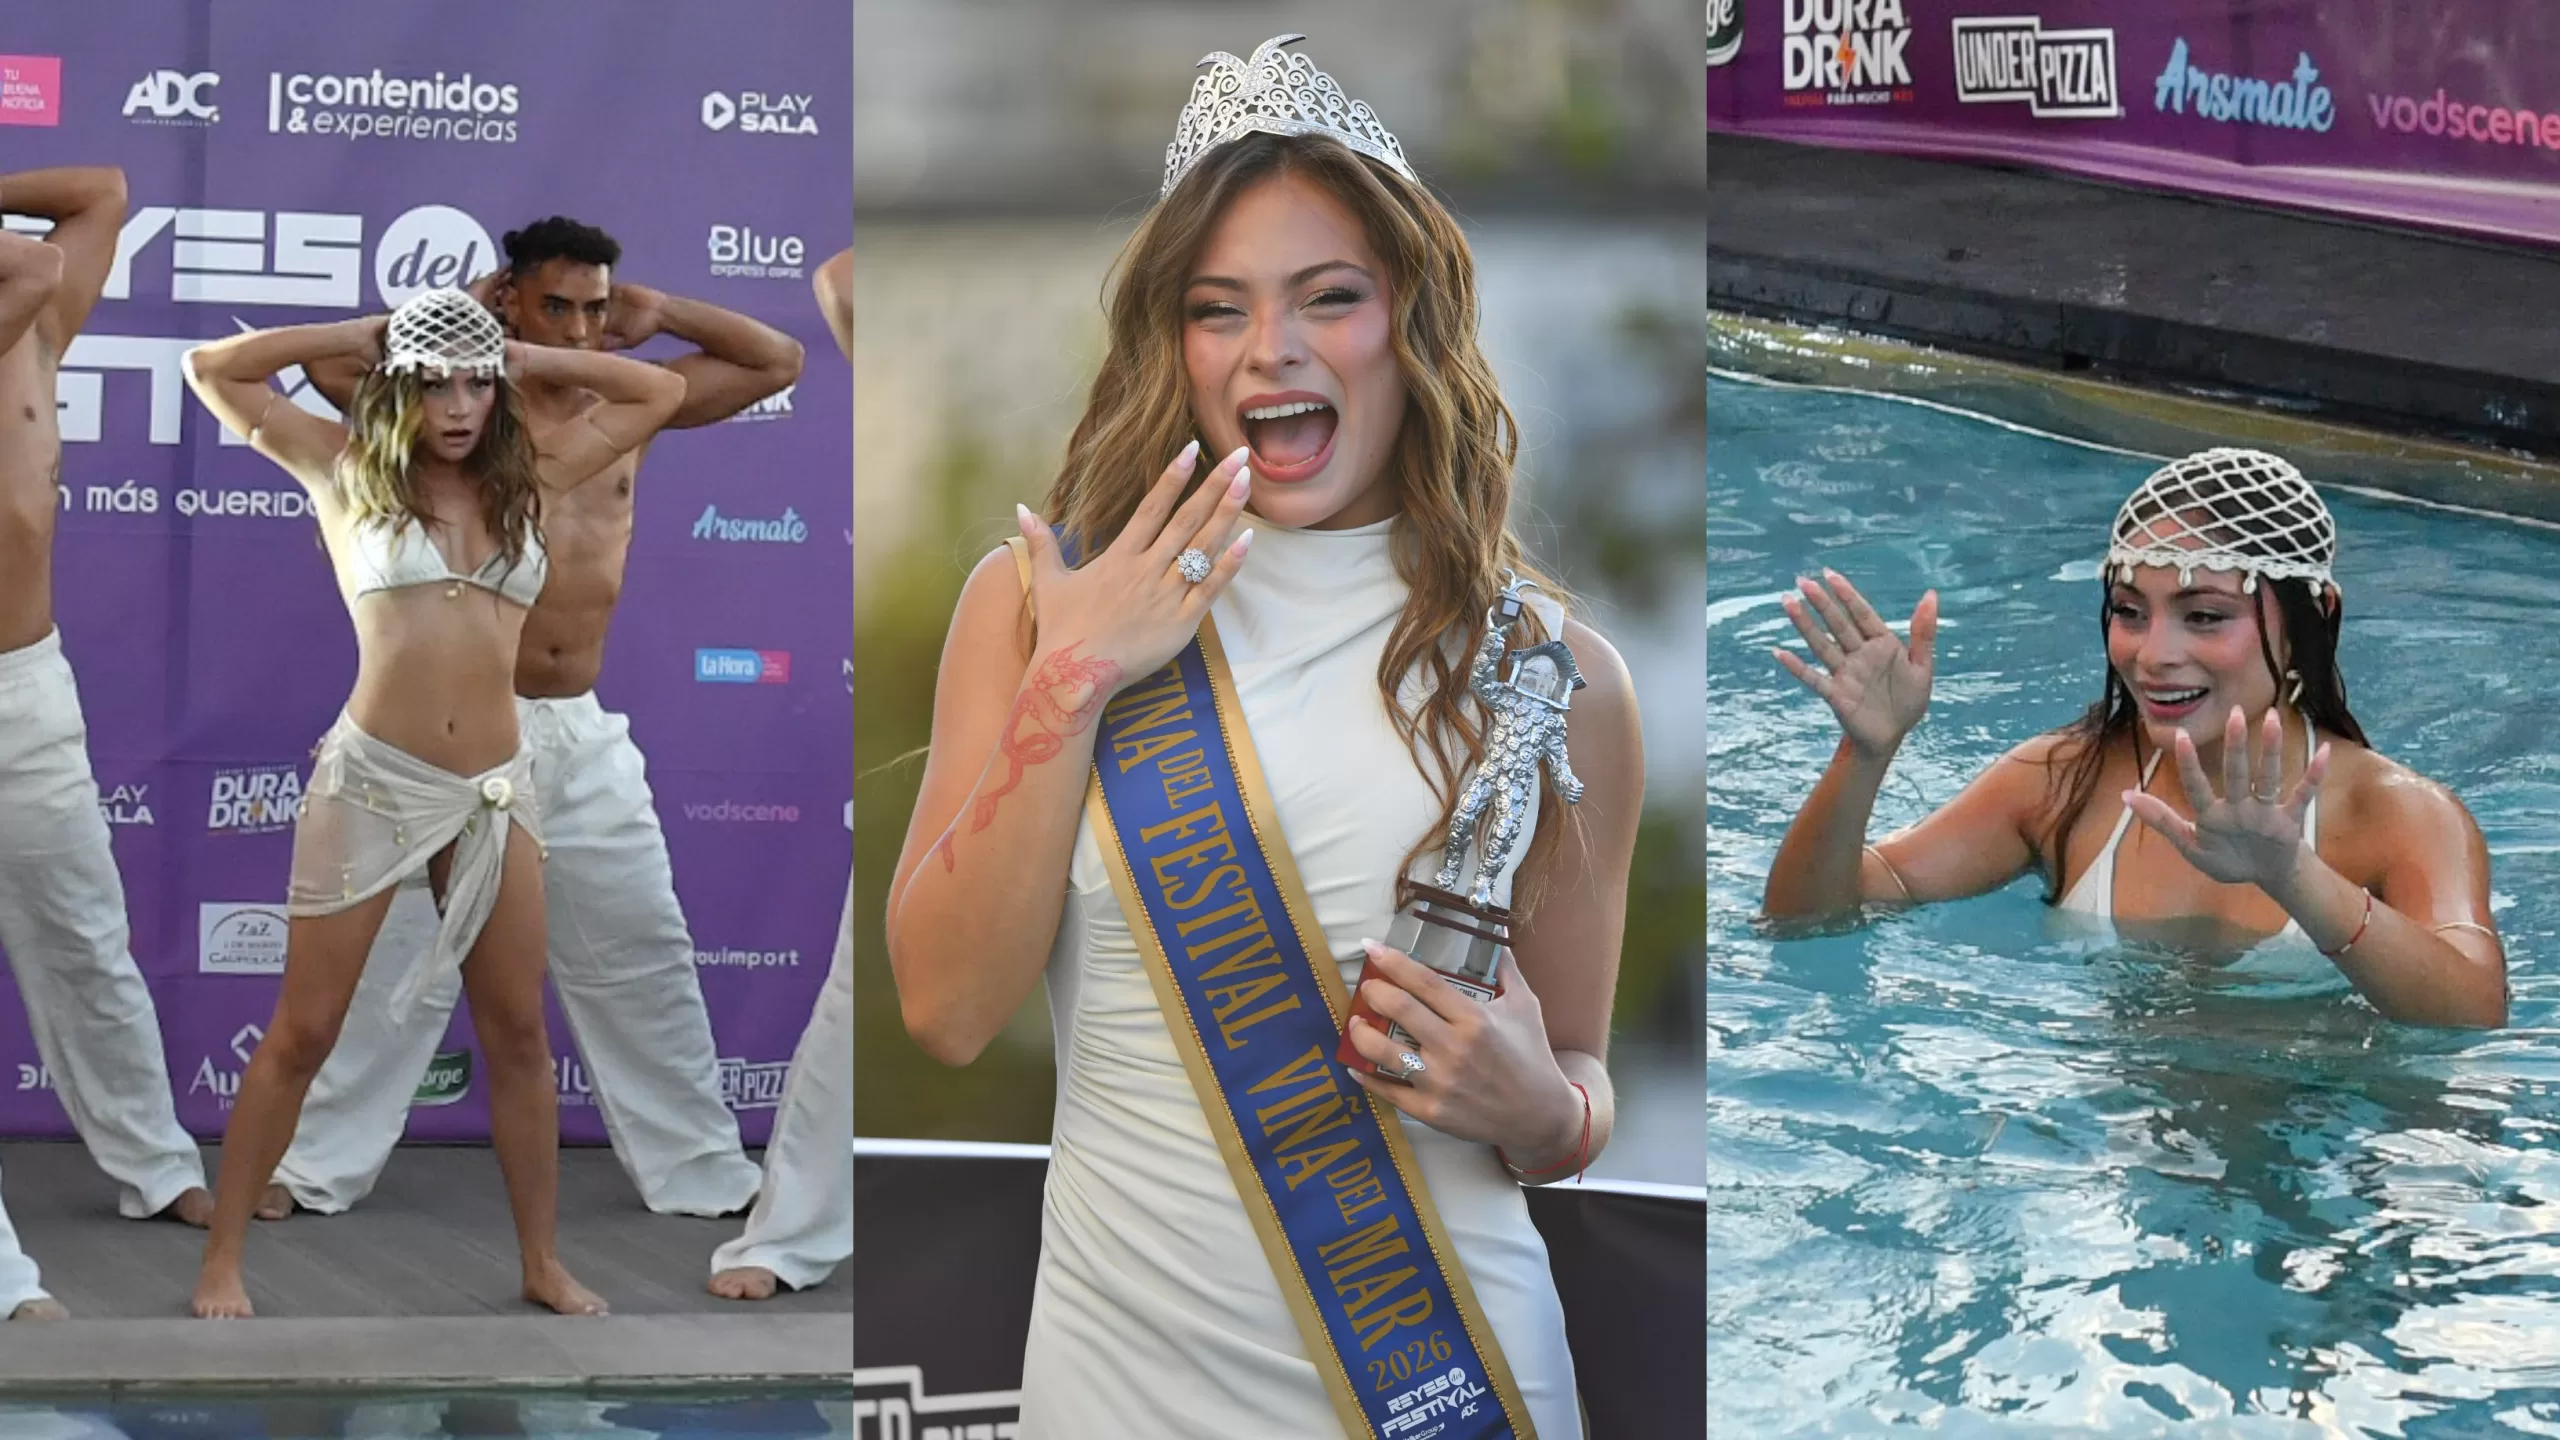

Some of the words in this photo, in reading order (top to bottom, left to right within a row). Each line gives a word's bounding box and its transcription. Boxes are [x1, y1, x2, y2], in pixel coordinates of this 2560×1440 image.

[1959, 31, 2037, 90] UNDER
[2040, 44, 2109, 104] PIZZA
[287, 68, 519, 114] contenidos
[741, 92, 813, 113] PLAY
[2155, 37, 2336, 133] Arsmate
[739, 113, 819, 135] SALA
[2368, 88, 2560, 149] vodscene
[388, 238, 482, 289] del
[708, 225, 804, 265] Blue
[86, 480, 159, 513] más
[692, 504, 808, 543] Arsmate
[212, 770, 300, 801] DURA
[1157, 748, 1215, 810] DEL
[683, 799, 800, 821] vodscene
[1139, 800, 1301, 1051] FESTIVAL
[419, 1066, 463, 1089] orge
[743, 1069, 782, 1101] PIZZ
[1245, 1045, 1363, 1192] VIÑA
[1326, 1157, 1388, 1225] DEL
[1317, 1213, 1434, 1352] MAR
[1367, 1330, 1452, 1392] 2026
[1381, 1381, 1486, 1438] FESTIVAL
[1386, 1374, 1450, 1415] REYES
[1461, 1401, 1479, 1420] ADC
